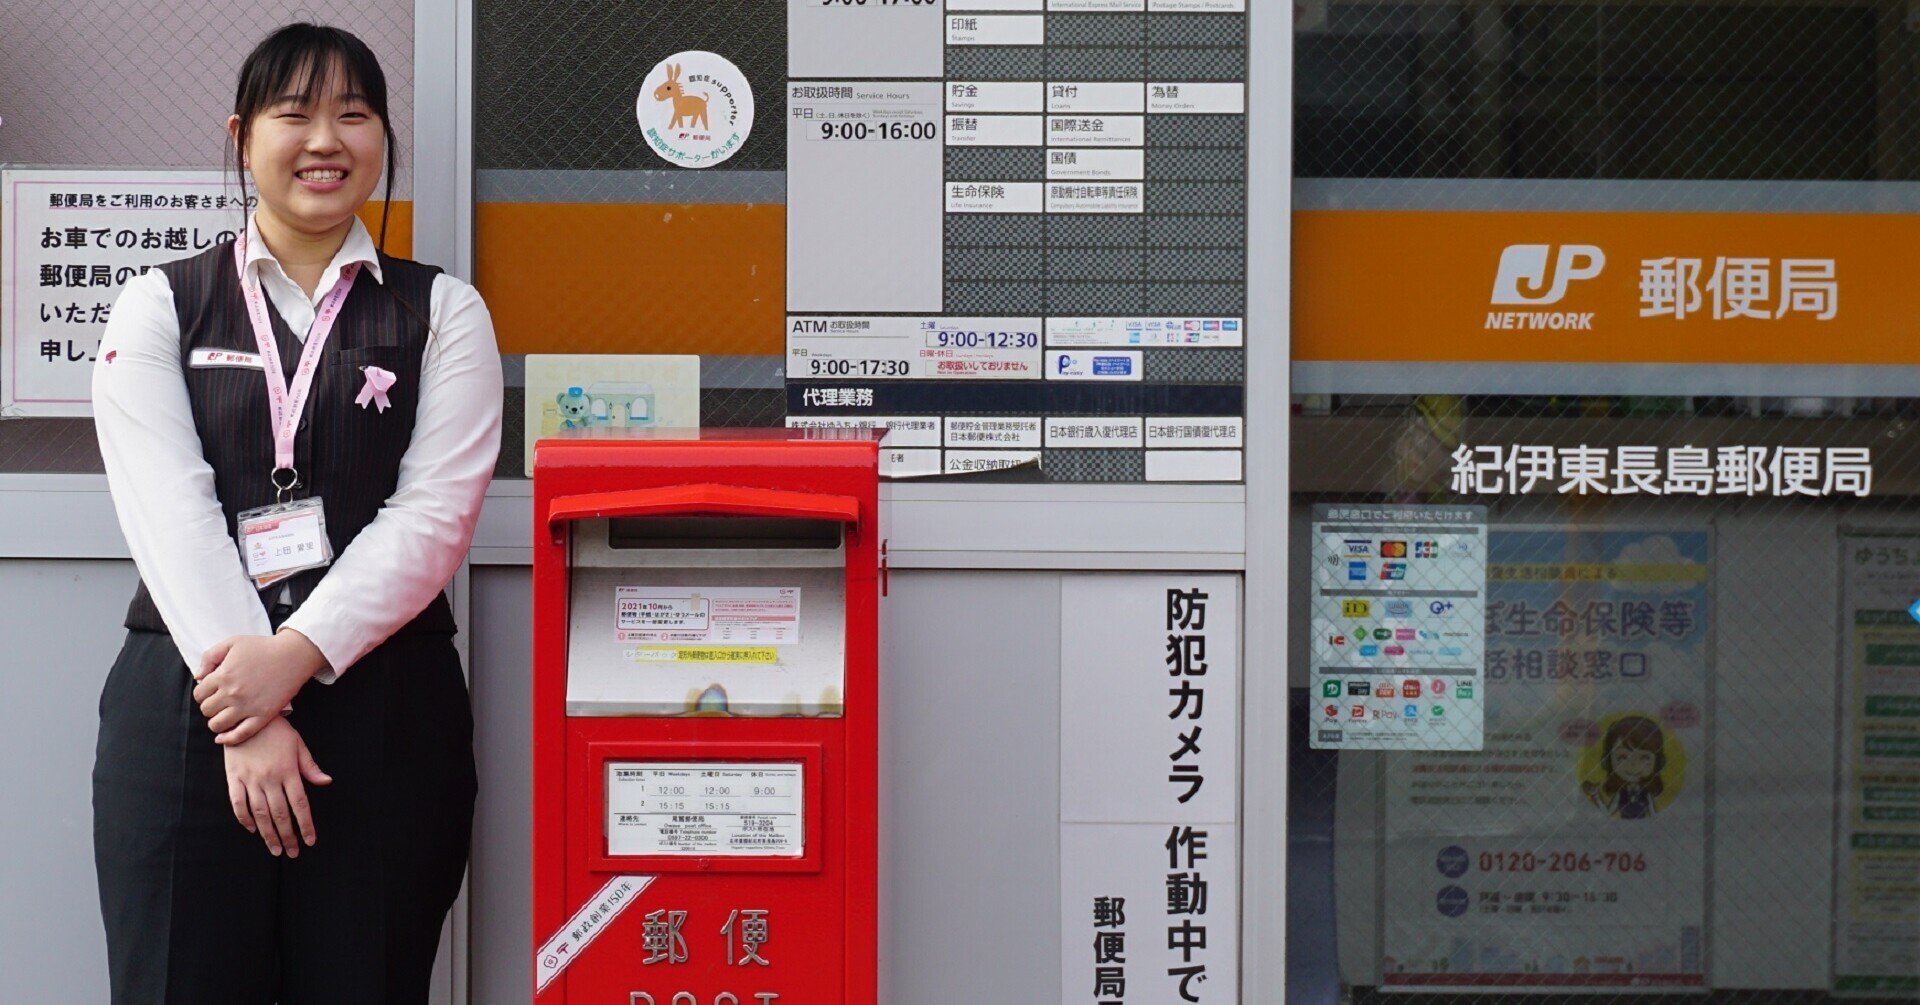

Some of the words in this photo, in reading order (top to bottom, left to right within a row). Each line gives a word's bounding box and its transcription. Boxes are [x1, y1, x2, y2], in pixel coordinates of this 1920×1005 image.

[951, 17, 978, 31] 印紙
[791, 86, 853, 99] お取扱時間
[952, 84, 978, 97] 貯金
[1052, 85, 1077, 98] 貸付
[1151, 85, 1179, 98] 為替
[710, 79, 738, 127] supporter
[792, 107, 813, 119] 平日
[821, 122, 936, 140] 9:00-16:00
[951, 117, 978, 131] 振替
[1051, 119, 1104, 132] 国際送金
[1051, 151, 1077, 165] 国債
[951, 184, 1005, 199] 生命保険
[1051, 186, 1138, 199] 原動機付自転車等責任保険
[49, 193, 258, 209] 郵便局をご利用のお客さまへの
[40, 226, 245, 250] お車でのお越しの
[1490, 243, 1606, 306] JP
[1639, 256, 1839, 321] 郵便局
[792, 320, 827, 333] ATM
[830, 320, 870, 330] お取扱時間
[920, 321, 936, 330] 土曜
[1484, 311, 1595, 331] NETWORK
[938, 331, 1038, 348] 9:00-12:30
[792, 348, 808, 357] 平日
[811, 360, 910, 375] 9:00-17:30
[937, 361, 1029, 371] お取扱いしておりません
[803, 387, 874, 407] 代理業務
[950, 421, 1037, 432] 郵便貯金管理業務受託者
[1050, 425, 1138, 439] 日本銀行歳入復代理店
[1149, 425, 1236, 439] 日本銀行国債復代理店
[950, 432, 1020, 442] 日本郵便株式会社
[1450, 443, 1872, 497] 紀伊東長島郵便局
[1348, 544, 1369, 554] VISA
[1166, 587, 1209, 804] 防犯カメラ
[658, 786, 685, 795] 12:00
[705, 786, 730, 795] 12:00
[753, 786, 776, 795] 9:00
[658, 802, 685, 810] 15:15
[705, 802, 730, 810] 15:15
[1479, 851, 1647, 872] 0120-206-706
[570, 880, 634, 943] 郵政創業150年
[1165, 826, 1208, 1003] 作動中で
[641, 908, 770, 967] 郵便
[1093, 895, 1126, 1005] 郵便局
